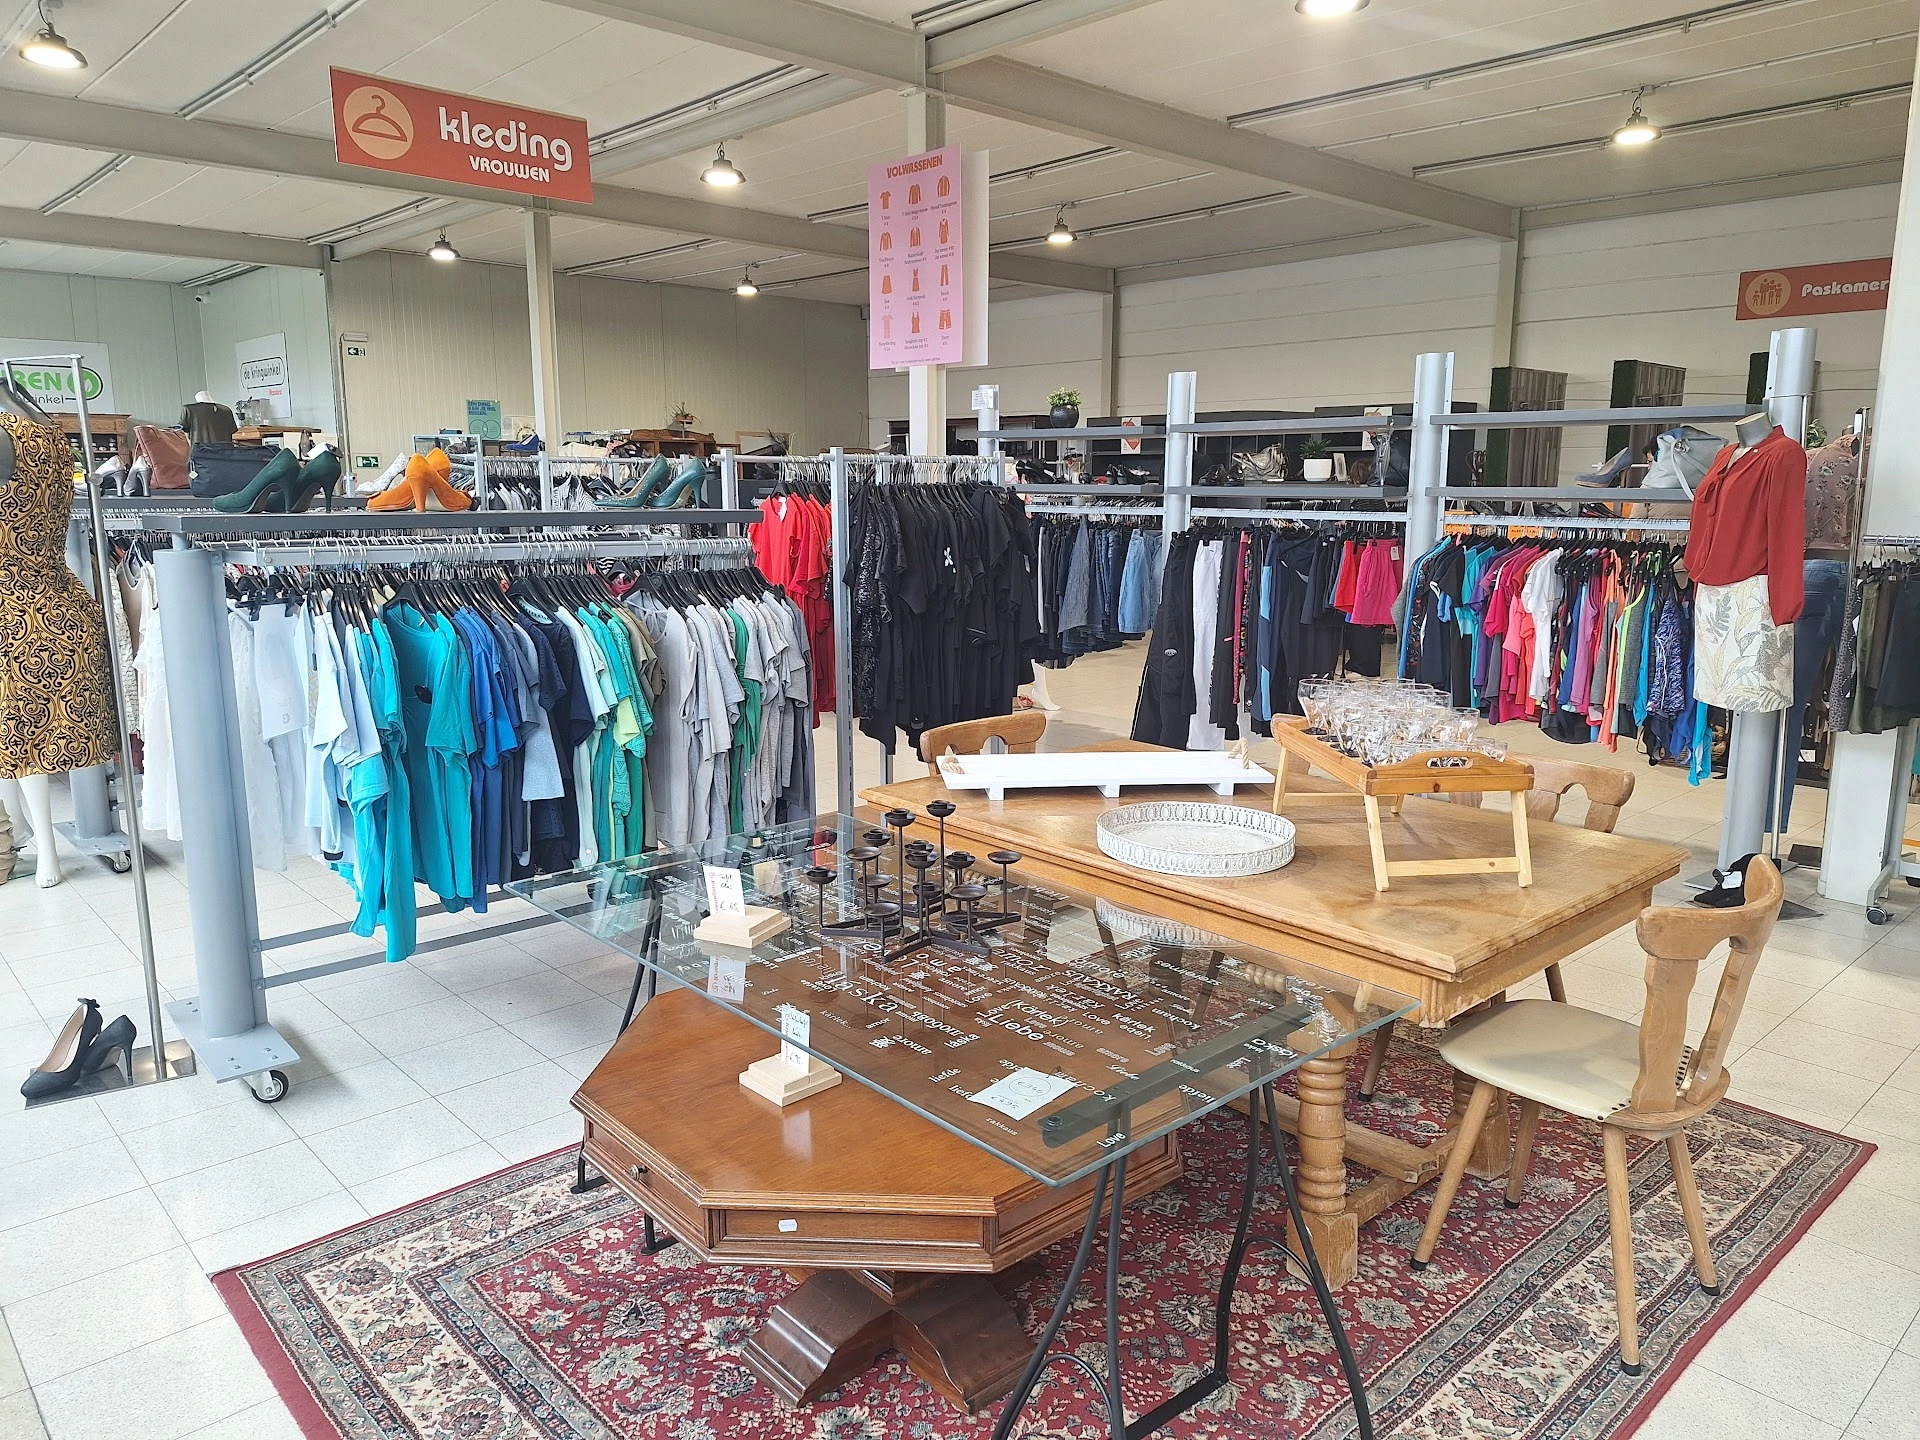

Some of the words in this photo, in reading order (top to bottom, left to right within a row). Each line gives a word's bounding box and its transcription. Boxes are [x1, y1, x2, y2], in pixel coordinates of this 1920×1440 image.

[438, 106, 573, 171] kleding
[469, 155, 550, 182] VROUWEN
[887, 155, 943, 178] VOLWASSENEN
[1062, 969, 1138, 1001] RAKKAUS
[988, 1013, 1045, 1041] Liebe
[1082, 1012, 1111, 1026] Love
[1151, 1008, 1201, 1031] kocham
[893, 1034, 933, 1055] amore
[928, 1067, 962, 1083] liefde
[1096, 1132, 1127, 1149] Love
